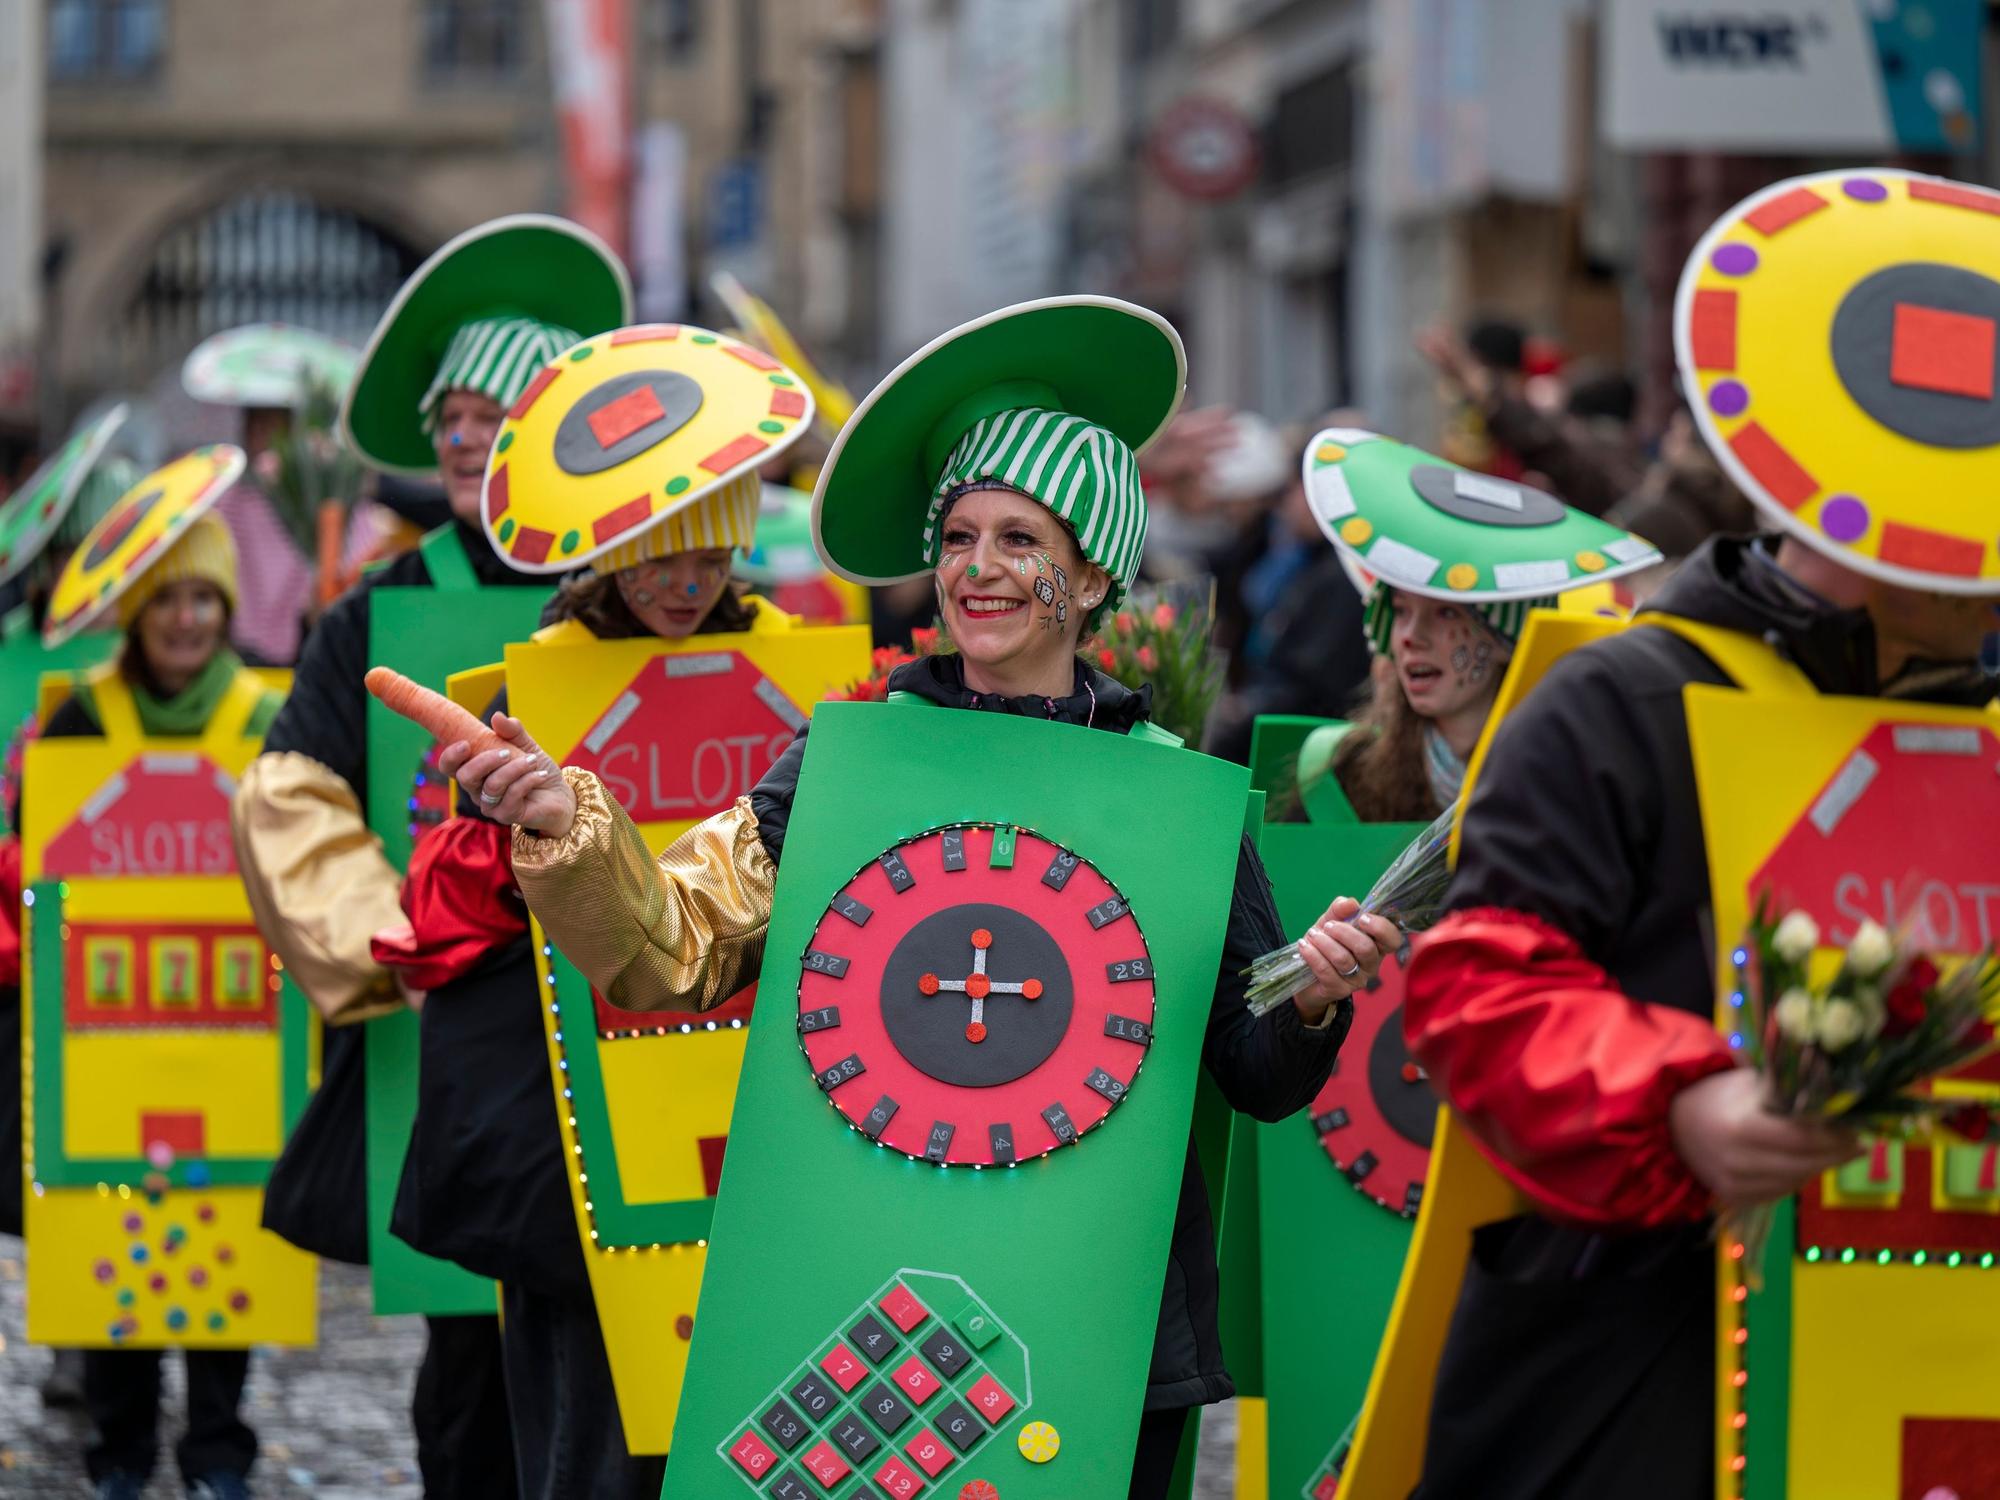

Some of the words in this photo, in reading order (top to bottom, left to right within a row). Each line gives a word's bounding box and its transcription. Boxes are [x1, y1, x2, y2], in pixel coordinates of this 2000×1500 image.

[90, 818, 231, 879] SLOTS
[1092, 900, 1122, 923] 12
[101, 950, 122, 992] 7
[166, 950, 187, 992] 7
[230, 950, 252, 992] 7
[1114, 961, 1145, 980] 28
[1114, 1019, 1144, 1039] 16
[1094, 1073, 1125, 1098] 32
[1050, 1110, 1075, 1138] 15
[927, 1128, 949, 1156] 21
[995, 1137, 1011, 1150] 4
[968, 1316, 985, 1331] 0
[866, 1333, 882, 1348] 4
[936, 1345, 953, 1362] 2
[837, 1360, 853, 1375] 7
[908, 1371, 926, 1388] 5
[799, 1384, 826, 1410] 10
[878, 1398, 894, 1414] 8
[983, 1391, 999, 1407] 3
[769, 1412, 797, 1438] 13
[950, 1418, 968, 1433] 6
[840, 1425, 866, 1450] 11
[738, 1442, 766, 1468] 16
[919, 1444, 936, 1460] 9
[809, 1452, 836, 1480] 14
[883, 1469, 911, 1495] 12
